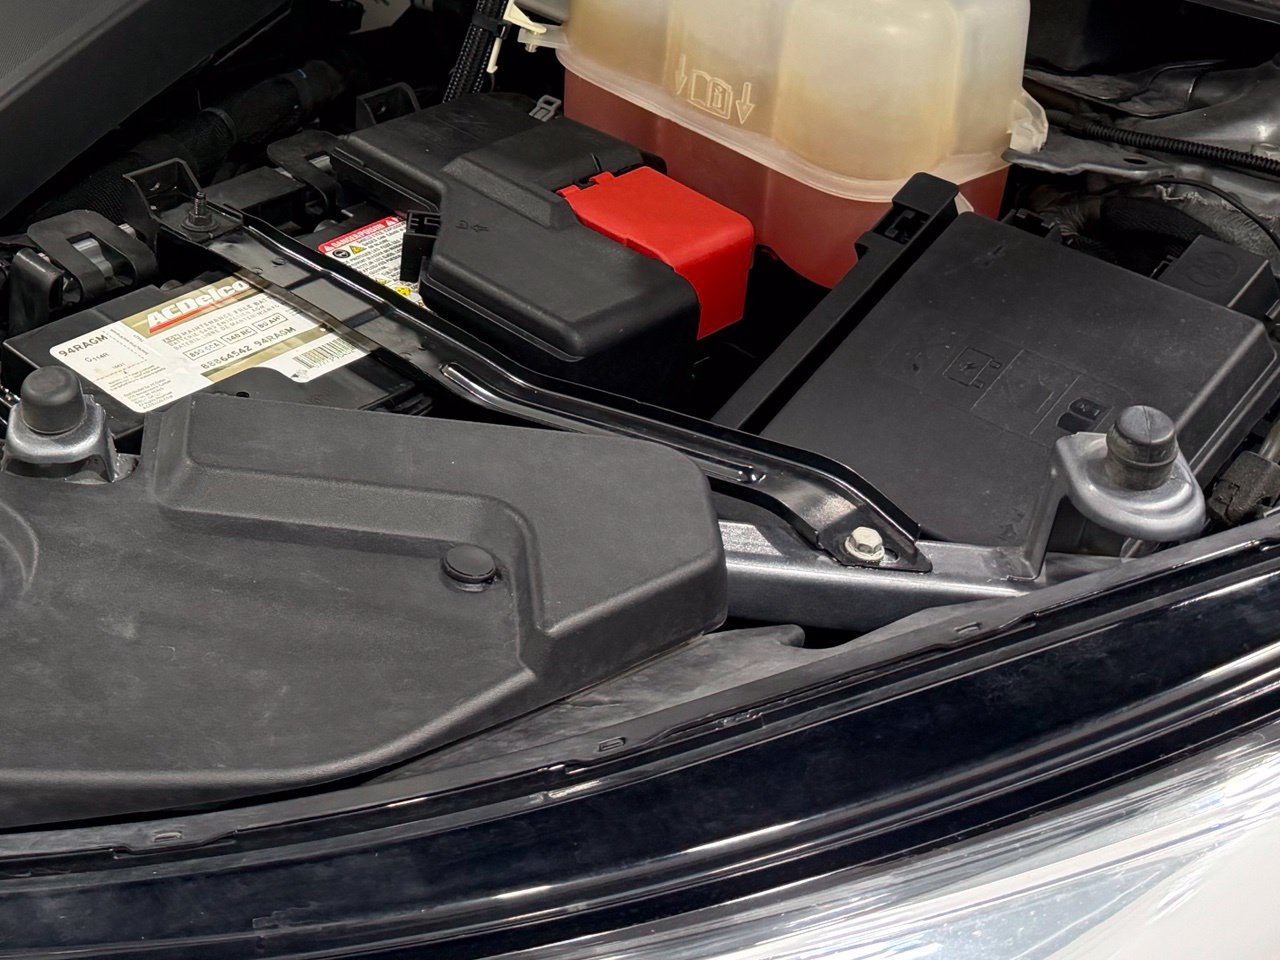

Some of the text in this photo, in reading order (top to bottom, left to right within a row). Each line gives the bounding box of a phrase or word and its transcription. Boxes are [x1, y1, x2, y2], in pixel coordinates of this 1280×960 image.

[146, 280, 250, 328] ACDelco
[58, 334, 108, 357] 94RAGM
[200, 326, 297, 370] 88864542 94RAGM
